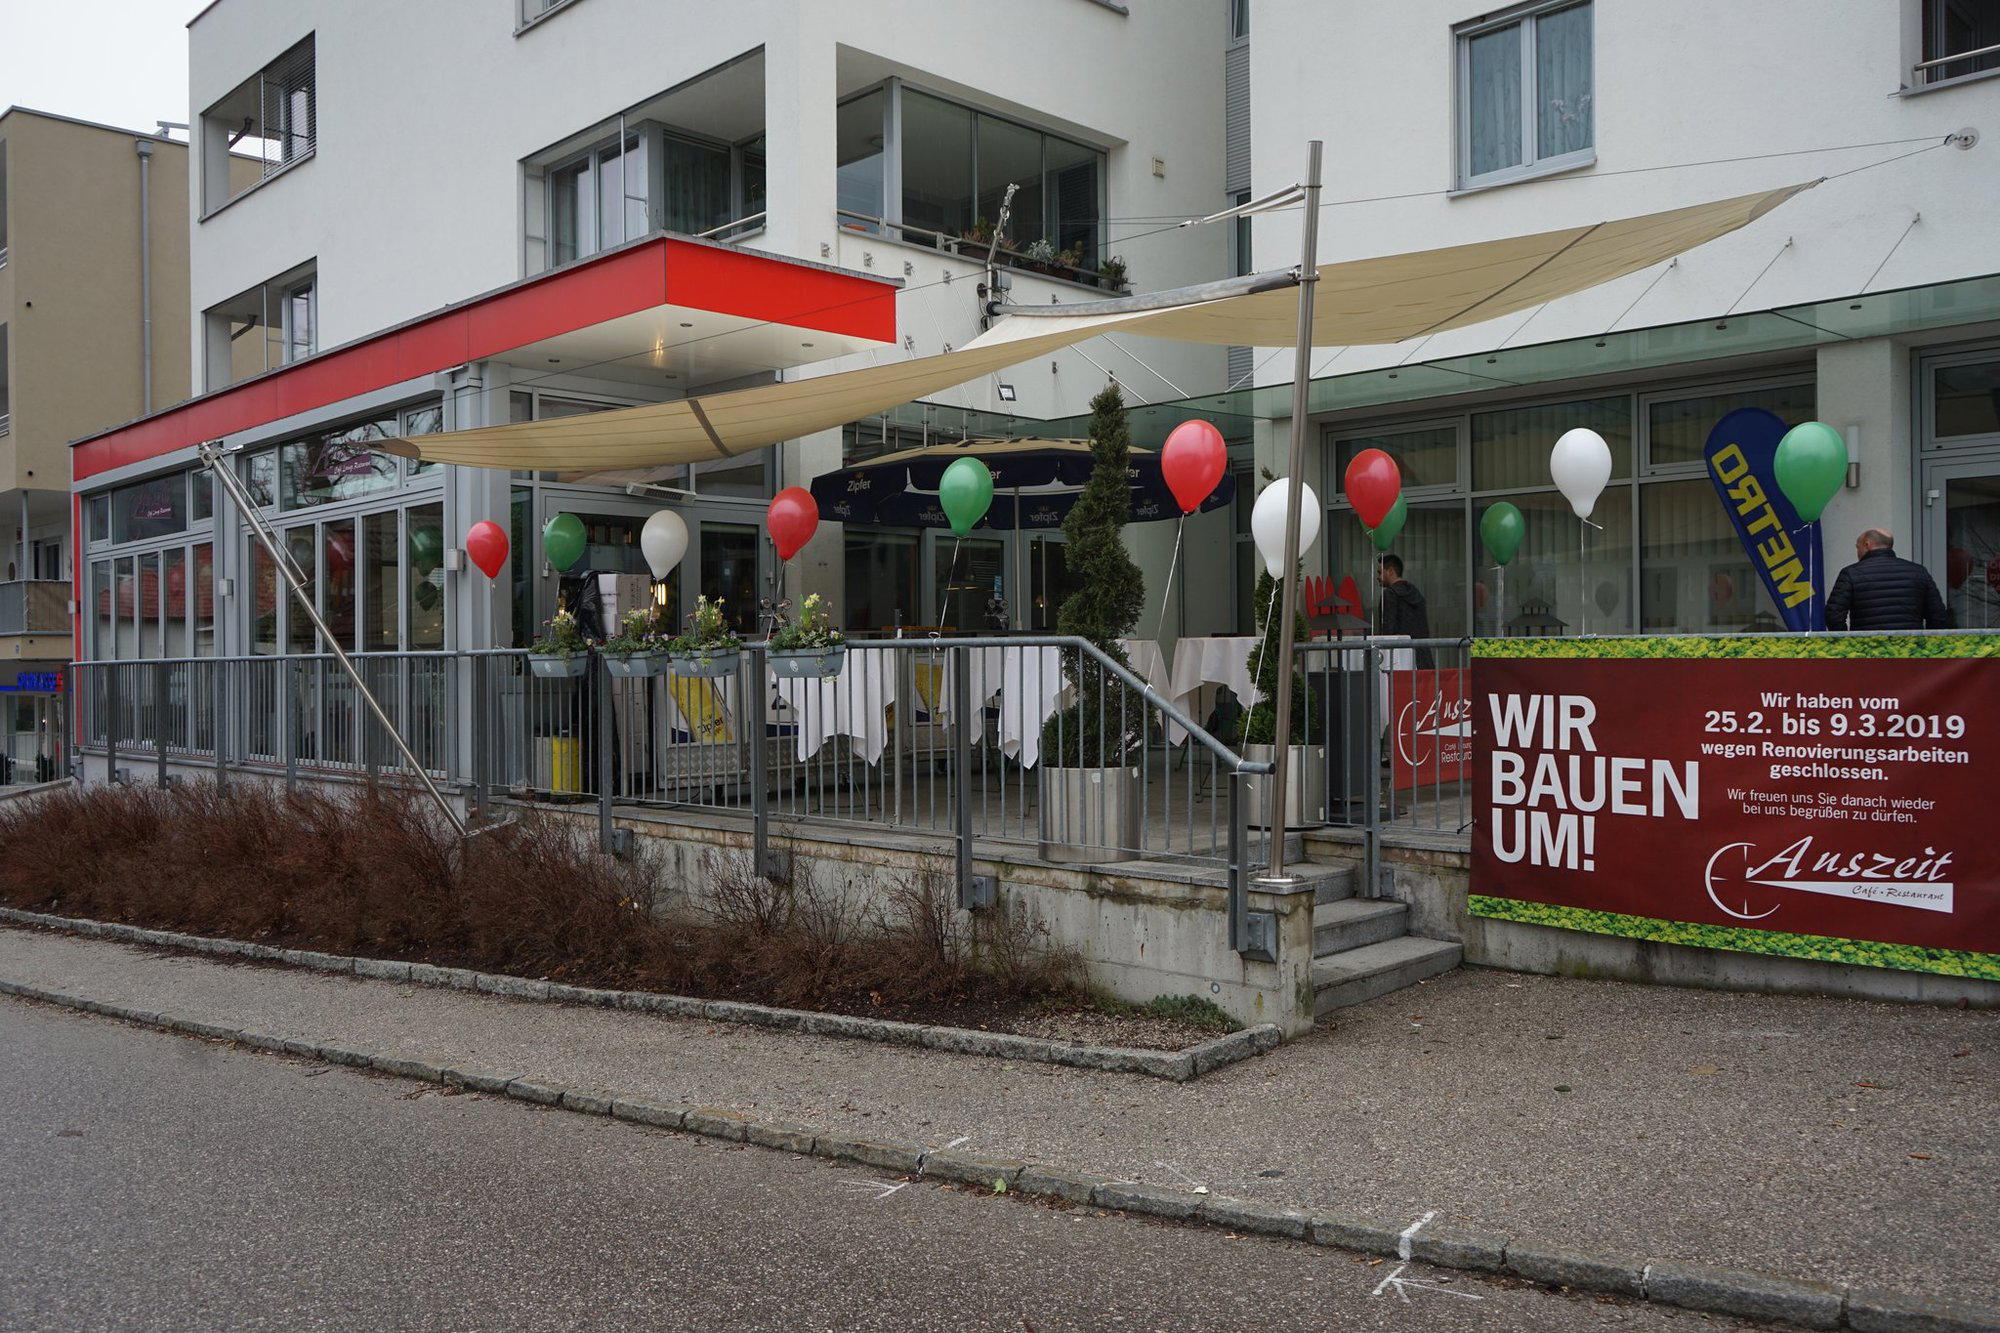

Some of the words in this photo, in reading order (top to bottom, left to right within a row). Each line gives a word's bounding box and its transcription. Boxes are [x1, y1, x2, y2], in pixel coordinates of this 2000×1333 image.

[847, 478, 871, 493] Zipfer
[1761, 692, 1791, 708] Wir
[1796, 693, 1853, 709] haben
[1859, 697, 1899, 710] vom
[1488, 693, 1598, 752] WIR
[1704, 710, 1772, 734] 25.2.
[1782, 712, 1821, 736] bis
[1830, 713, 1966, 739] 9.3.2019
[1701, 742, 1756, 758] wegen
[1762, 741, 1969, 763] Renovierungsarbeiten
[1770, 763, 1889, 780] geschlossen.
[1491, 750, 1699, 820] BAUEN
[1727, 788, 1746, 801] Wir
[1750, 790, 1788, 803] freuen
[1792, 794, 1813, 804] uns
[1818, 793, 1837, 805] Sie
[1841, 795, 1886, 808] danach
[1891, 797, 1935, 810] wieder
[1743, 803, 1761, 815] bei
[1765, 806, 1786, 816] uns
[1790, 805, 1848, 820] begrüßen
[1852, 811, 1867, 820] zu
[1872, 809, 1918, 823] dürfen.
[1491, 807, 1596, 872] UM!
[1745, 835, 1953, 882] Auszeit
[1852, 885, 1880, 898] Café
[1887, 887, 1945, 901] Restaurant
